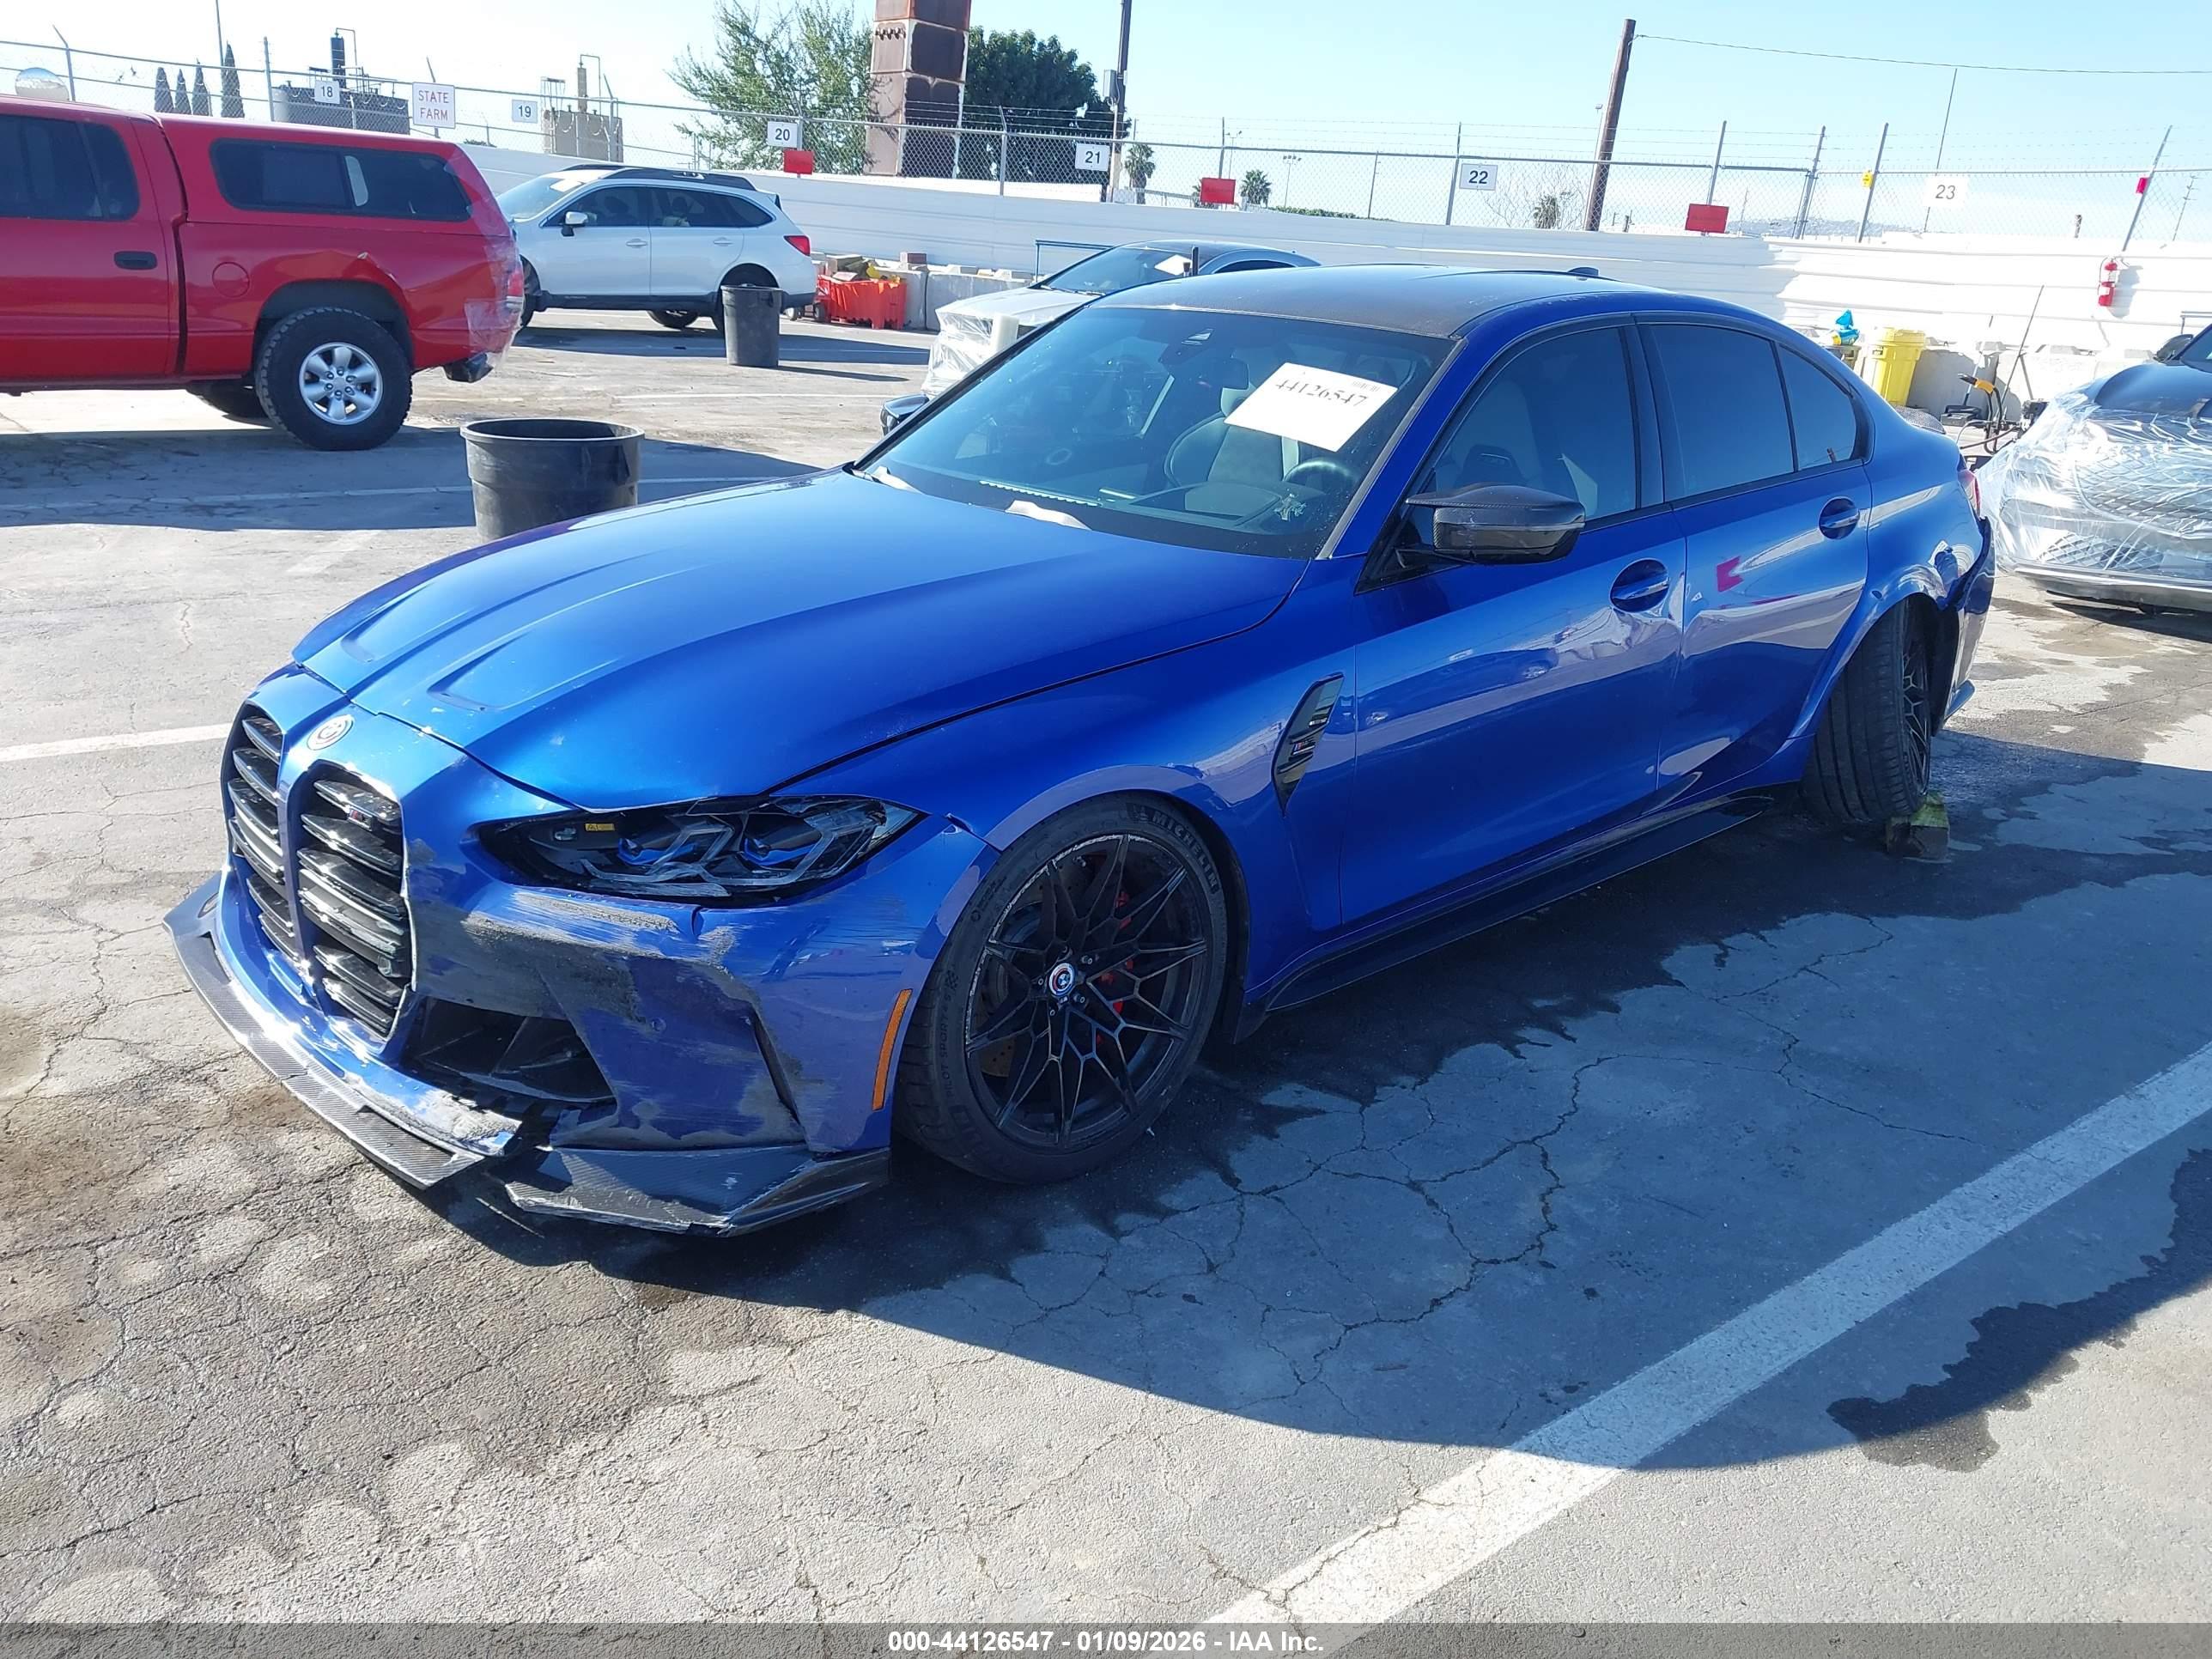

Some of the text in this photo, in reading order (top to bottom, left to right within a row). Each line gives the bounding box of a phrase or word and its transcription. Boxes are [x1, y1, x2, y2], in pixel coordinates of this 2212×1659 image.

[320, 85, 333, 98] 18
[418, 90, 449, 103] STATE
[420, 106, 448, 121] FARM
[518, 105, 532, 118] 19
[775, 128, 790, 142] 20
[1085, 150, 1100, 164] 21
[1468, 170, 1489, 185] 22
[1935, 184, 1956, 200] 23
[1275, 380, 1368, 407] 44126547
[1152, 809, 1218, 888] MICHELIN
